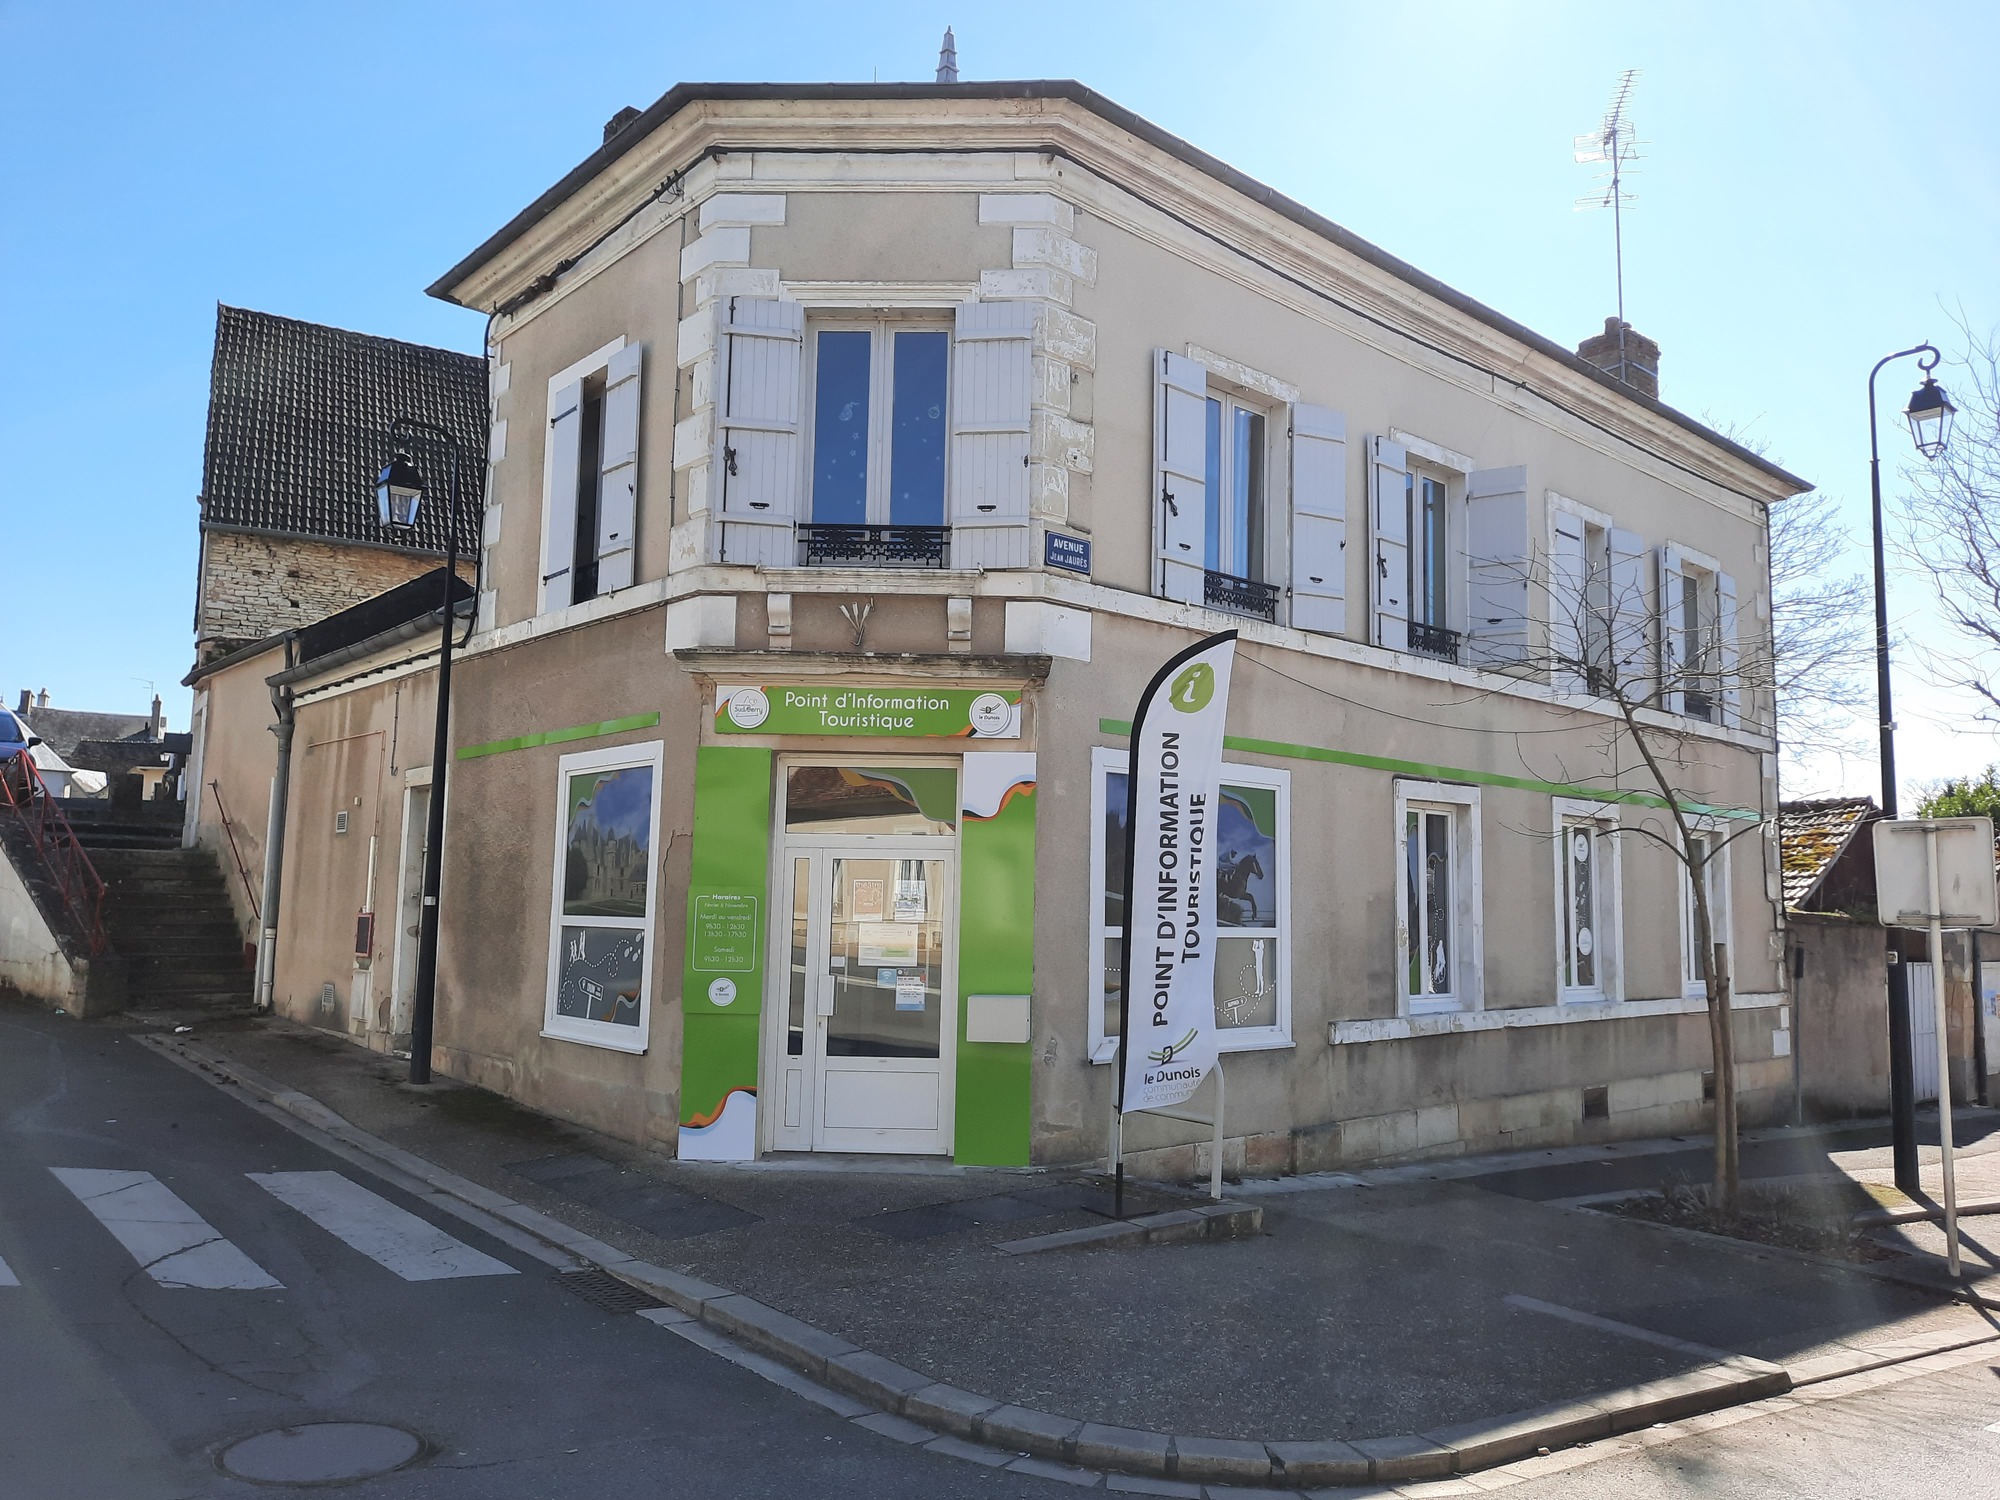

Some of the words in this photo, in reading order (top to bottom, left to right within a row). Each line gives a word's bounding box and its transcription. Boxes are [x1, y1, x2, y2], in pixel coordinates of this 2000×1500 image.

[1053, 538, 1085, 554] AVENUE
[1050, 551, 1064, 562] JEAN
[785, 691, 828, 708] Point
[835, 692, 949, 710] d'Information
[819, 710, 914, 731] Touristique
[1157, 732, 1180, 939] D'INFORMATION
[1181, 792, 1206, 964] TOURISTIQUE
[1153, 946, 1175, 1026] POINT
[1143, 1073, 1155, 1085] le
[1156, 1066, 1201, 1083] Dunois
